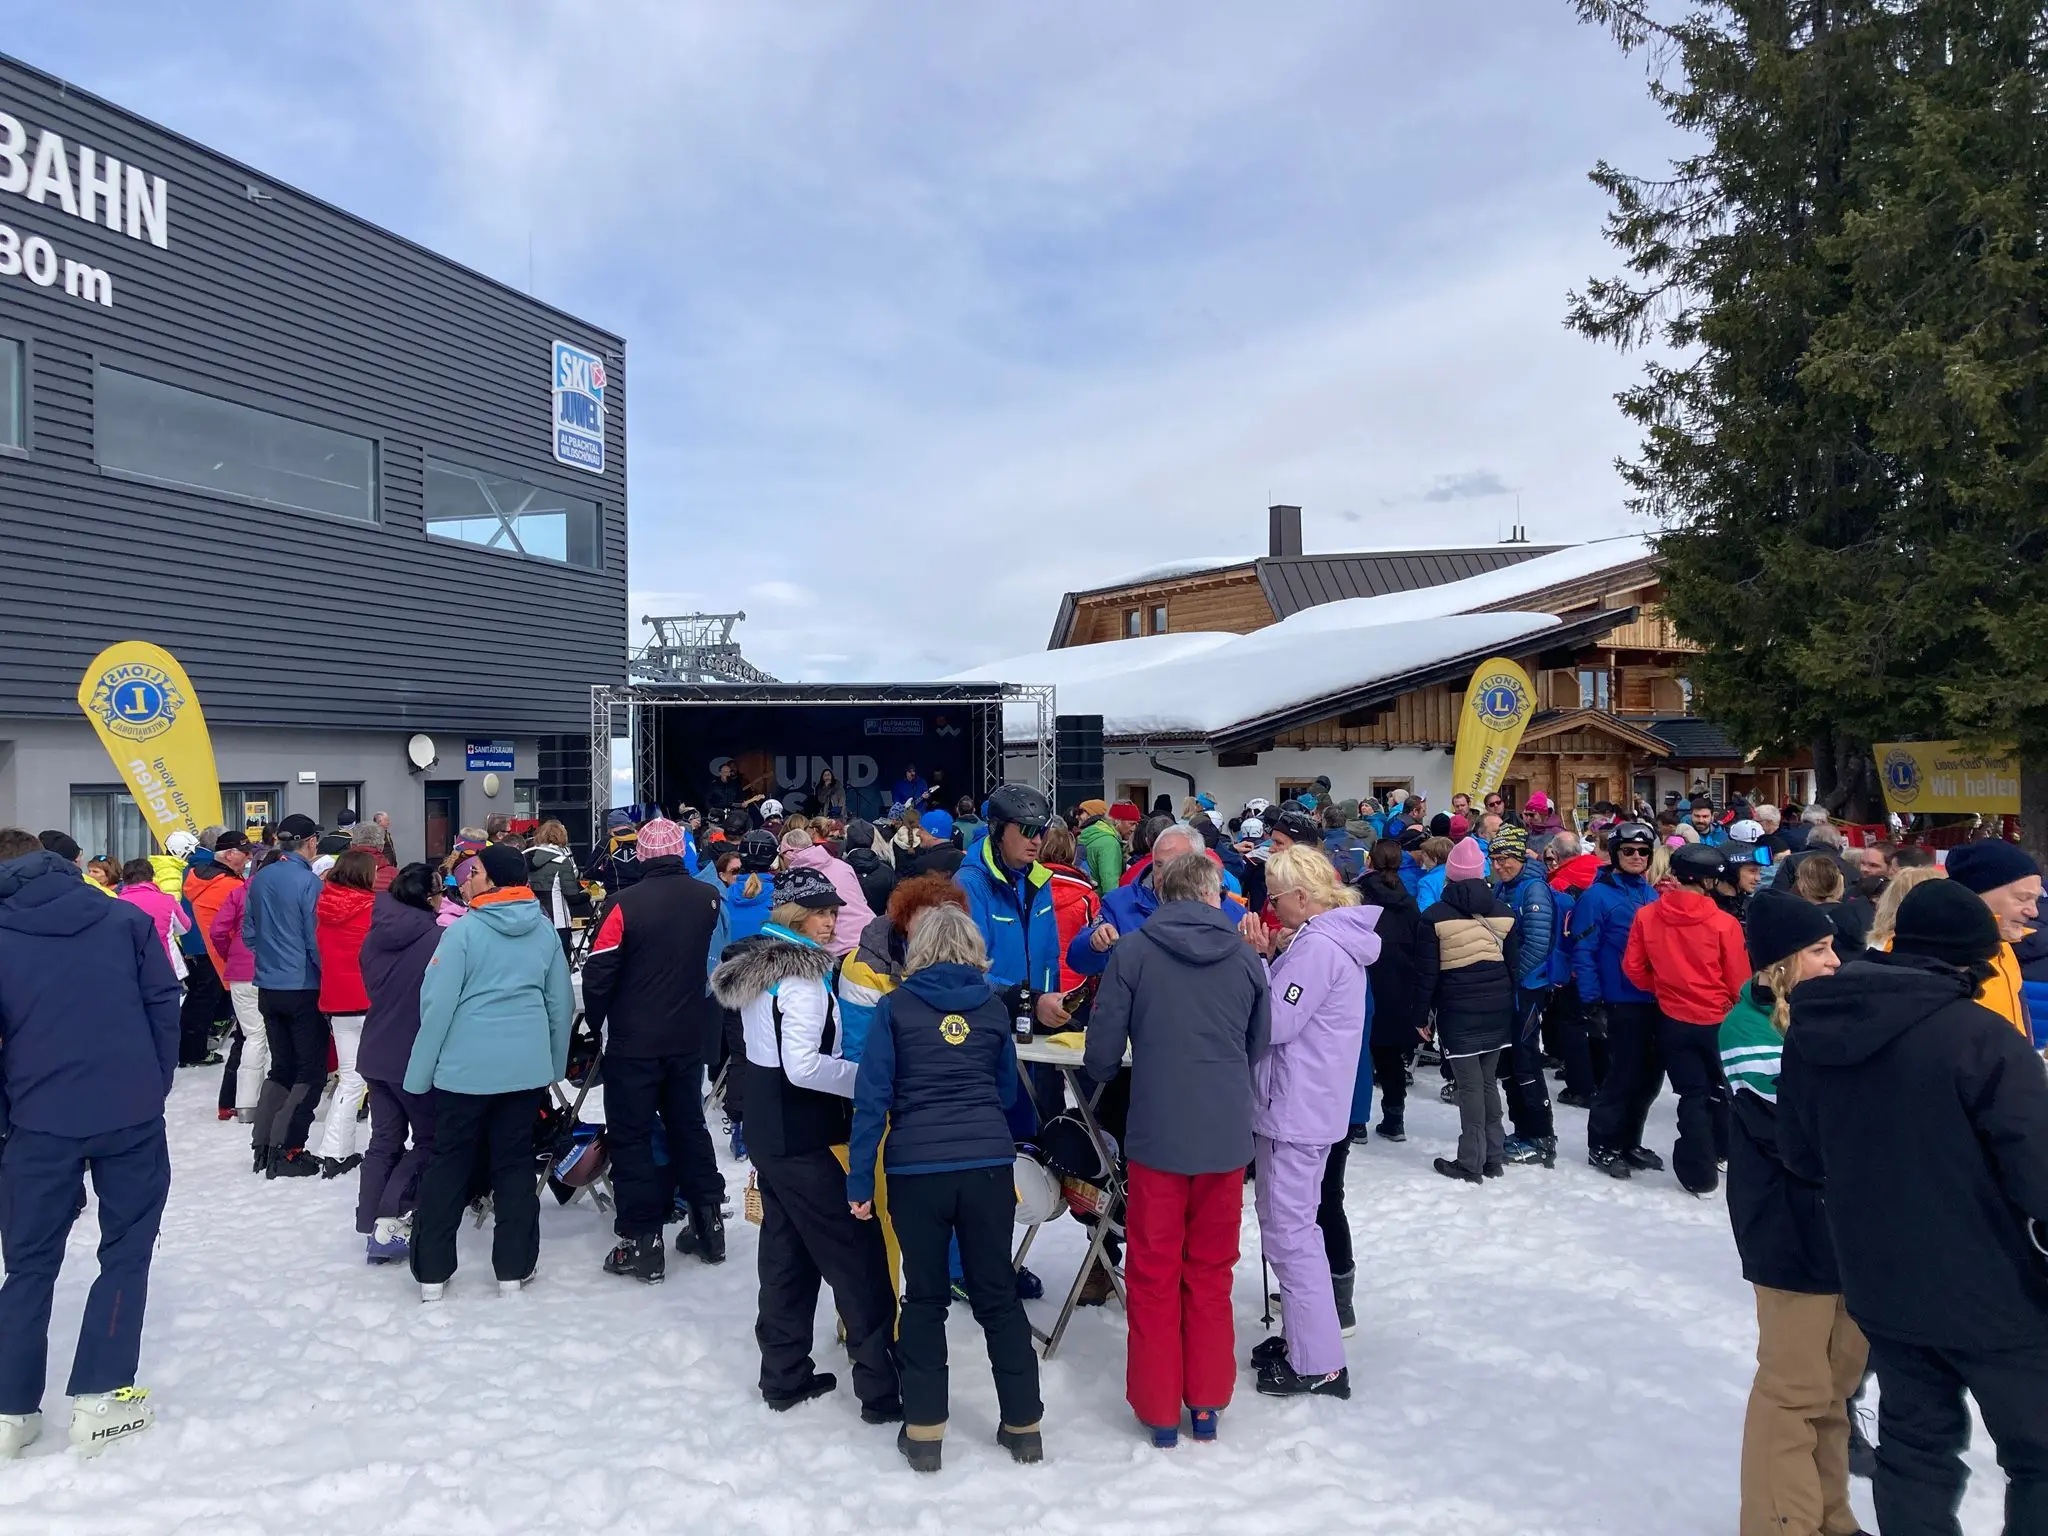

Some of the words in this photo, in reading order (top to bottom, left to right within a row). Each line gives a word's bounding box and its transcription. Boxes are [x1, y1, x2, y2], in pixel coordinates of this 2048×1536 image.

[65, 258, 113, 307] m
[561, 351, 589, 393] SKI
[561, 391, 600, 432] JUWEL
[561, 433, 600, 455] ALPBACHTAL
[1484, 676, 1519, 689] LIONS
[1478, 746, 1509, 796] helfen
[1930, 774, 1957, 797] Wir
[1964, 772, 2018, 797] helfen
[91, 1419, 145, 1441] HEAD
